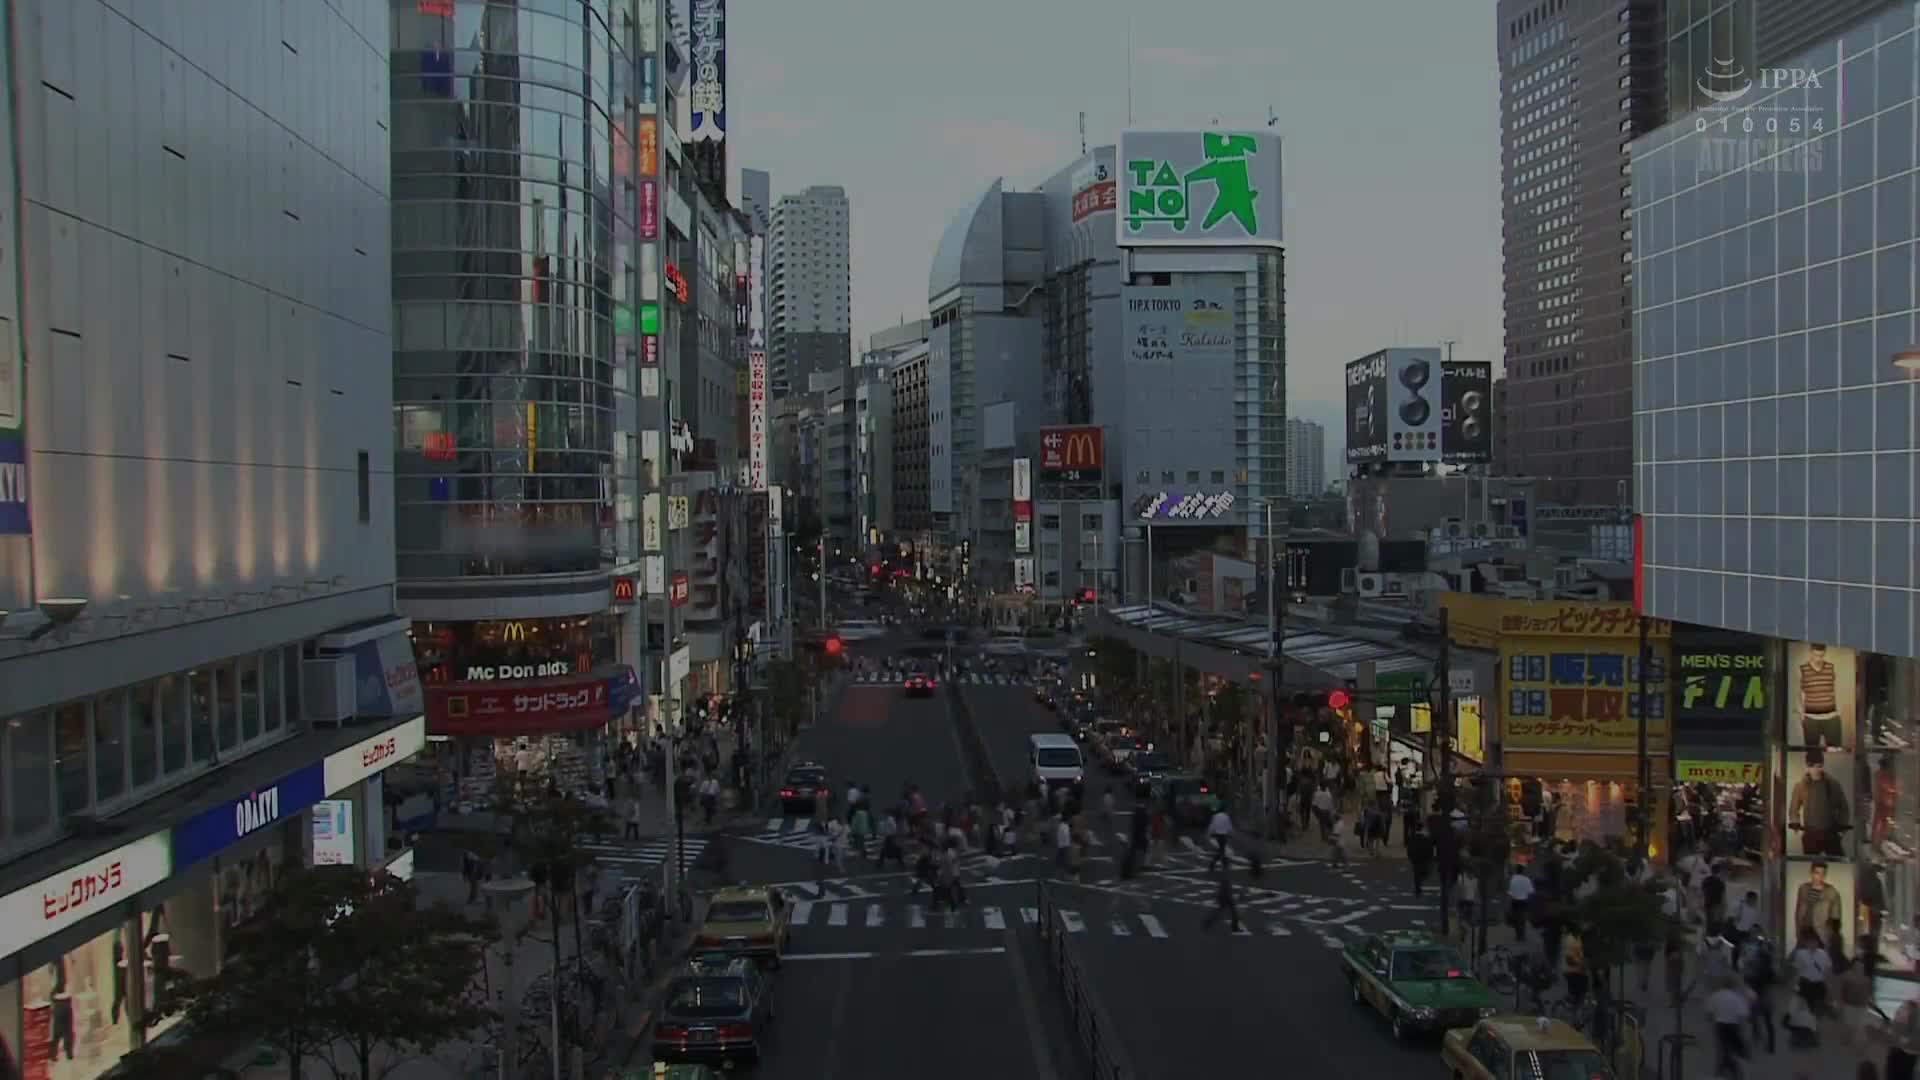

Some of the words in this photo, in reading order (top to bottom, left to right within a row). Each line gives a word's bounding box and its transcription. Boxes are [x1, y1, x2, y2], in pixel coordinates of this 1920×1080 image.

[1680, 654, 1731, 668] MEN'S
[1688, 766, 1736, 777] men's
[236, 785, 279, 837] ODAKYU
[43, 861, 121, 920] ビックカメラ
